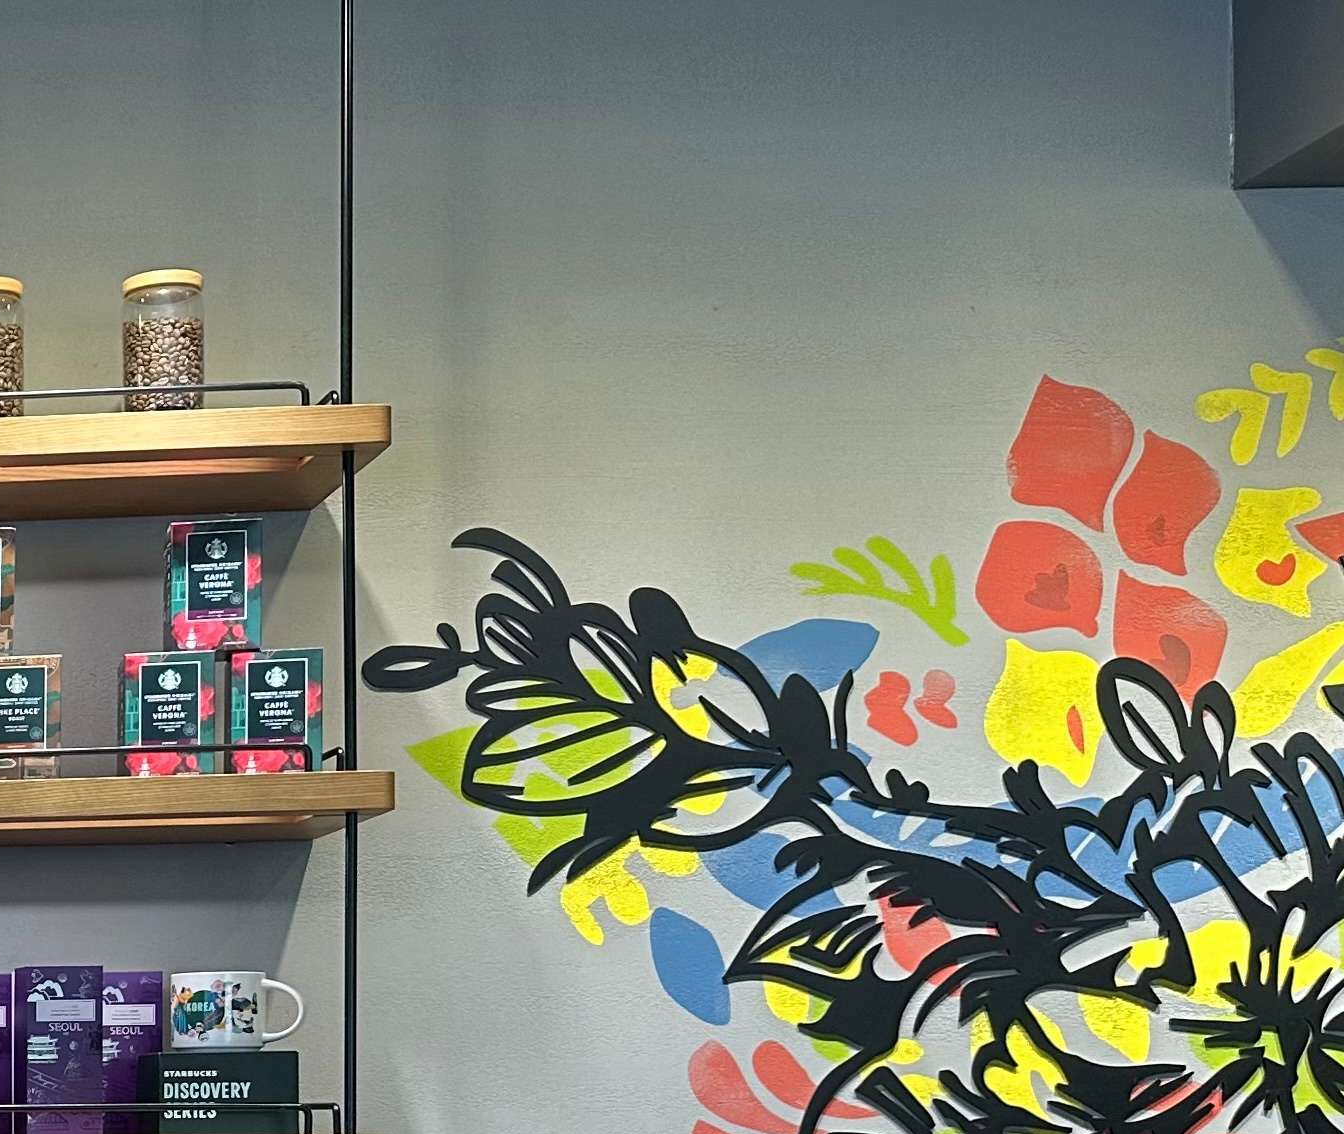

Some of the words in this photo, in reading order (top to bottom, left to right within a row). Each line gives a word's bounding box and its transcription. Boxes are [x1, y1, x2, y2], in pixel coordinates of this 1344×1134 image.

[185, 1002, 216, 1013] KOREA
[48, 1022, 83, 1033] SEOUL
[109, 1026, 144, 1036] SEOUL
[163, 1070, 218, 1078] STARBUCKS
[163, 1082, 252, 1099] DISCOVERY
